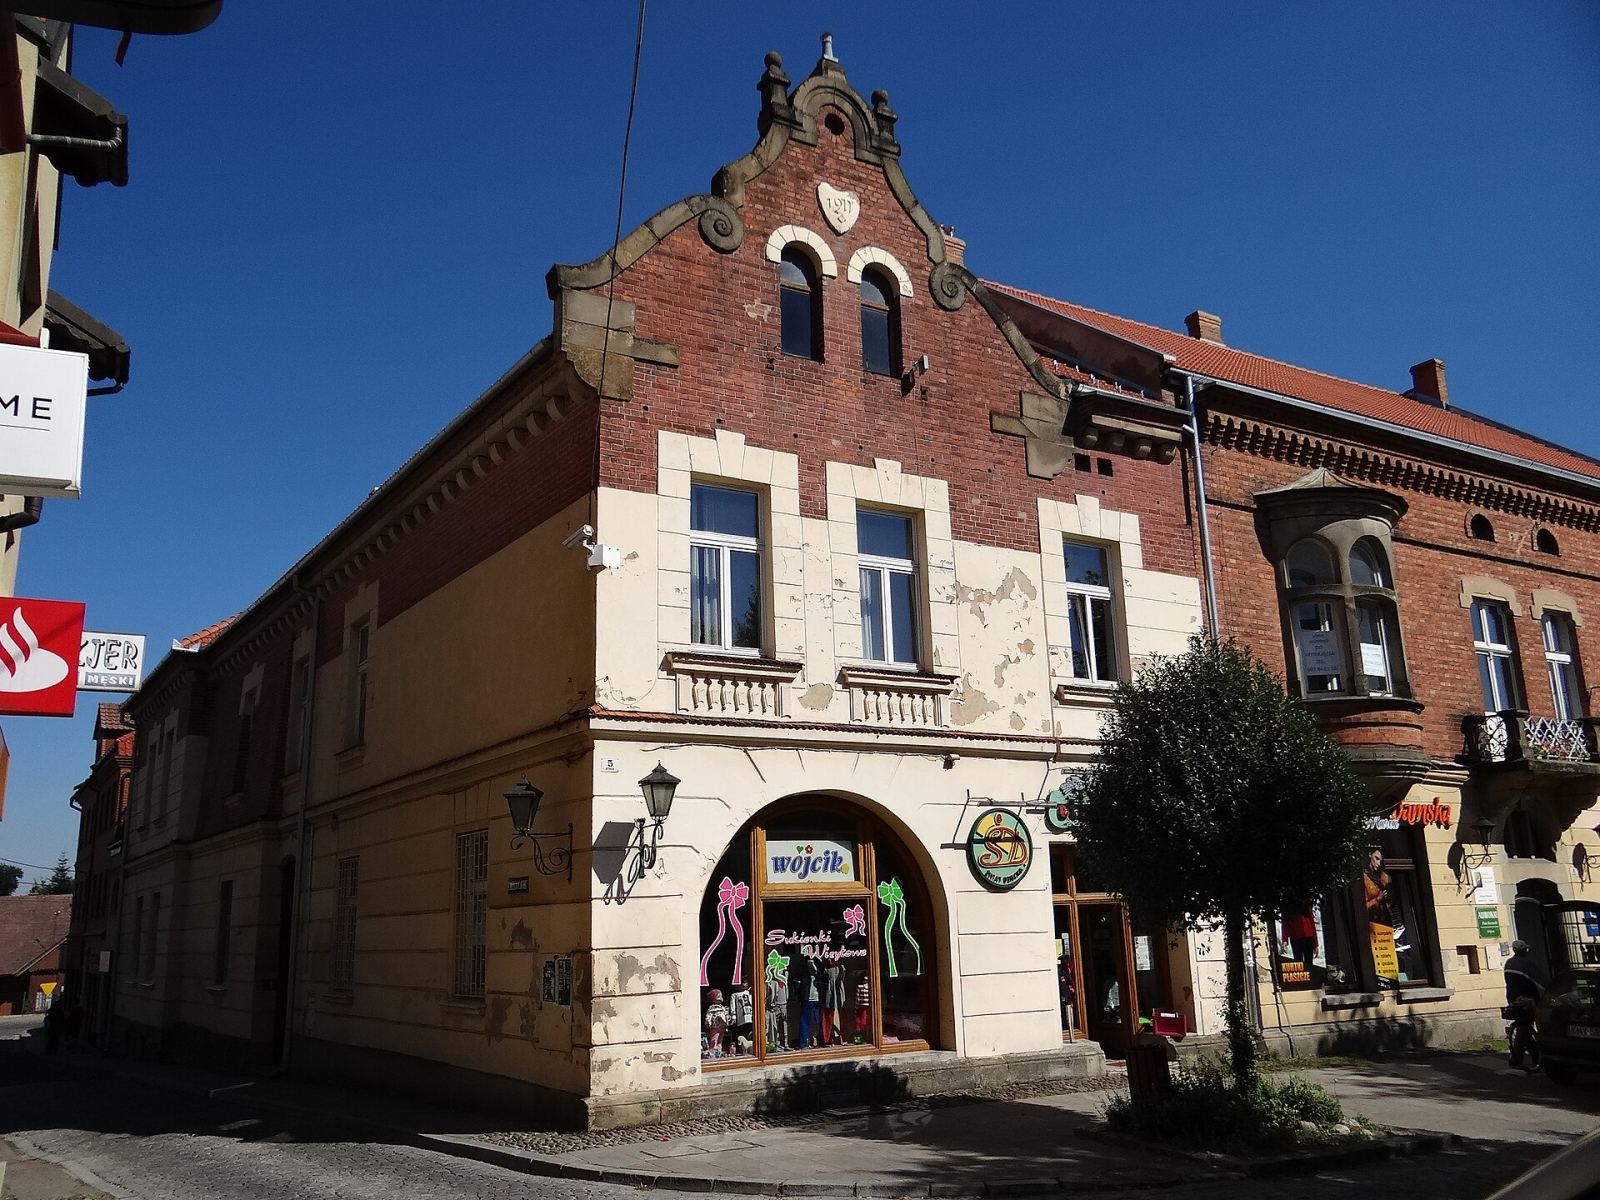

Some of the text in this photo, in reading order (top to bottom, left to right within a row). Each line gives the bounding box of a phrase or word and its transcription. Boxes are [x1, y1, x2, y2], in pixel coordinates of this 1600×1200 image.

[0, 395, 52, 420] ME
[87, 674, 134, 687] MĘSKI
[765, 929, 832, 945] Sukienki
[803, 944, 867, 962] Wizytowe
[1281, 962, 1304, 972] KURTKI
